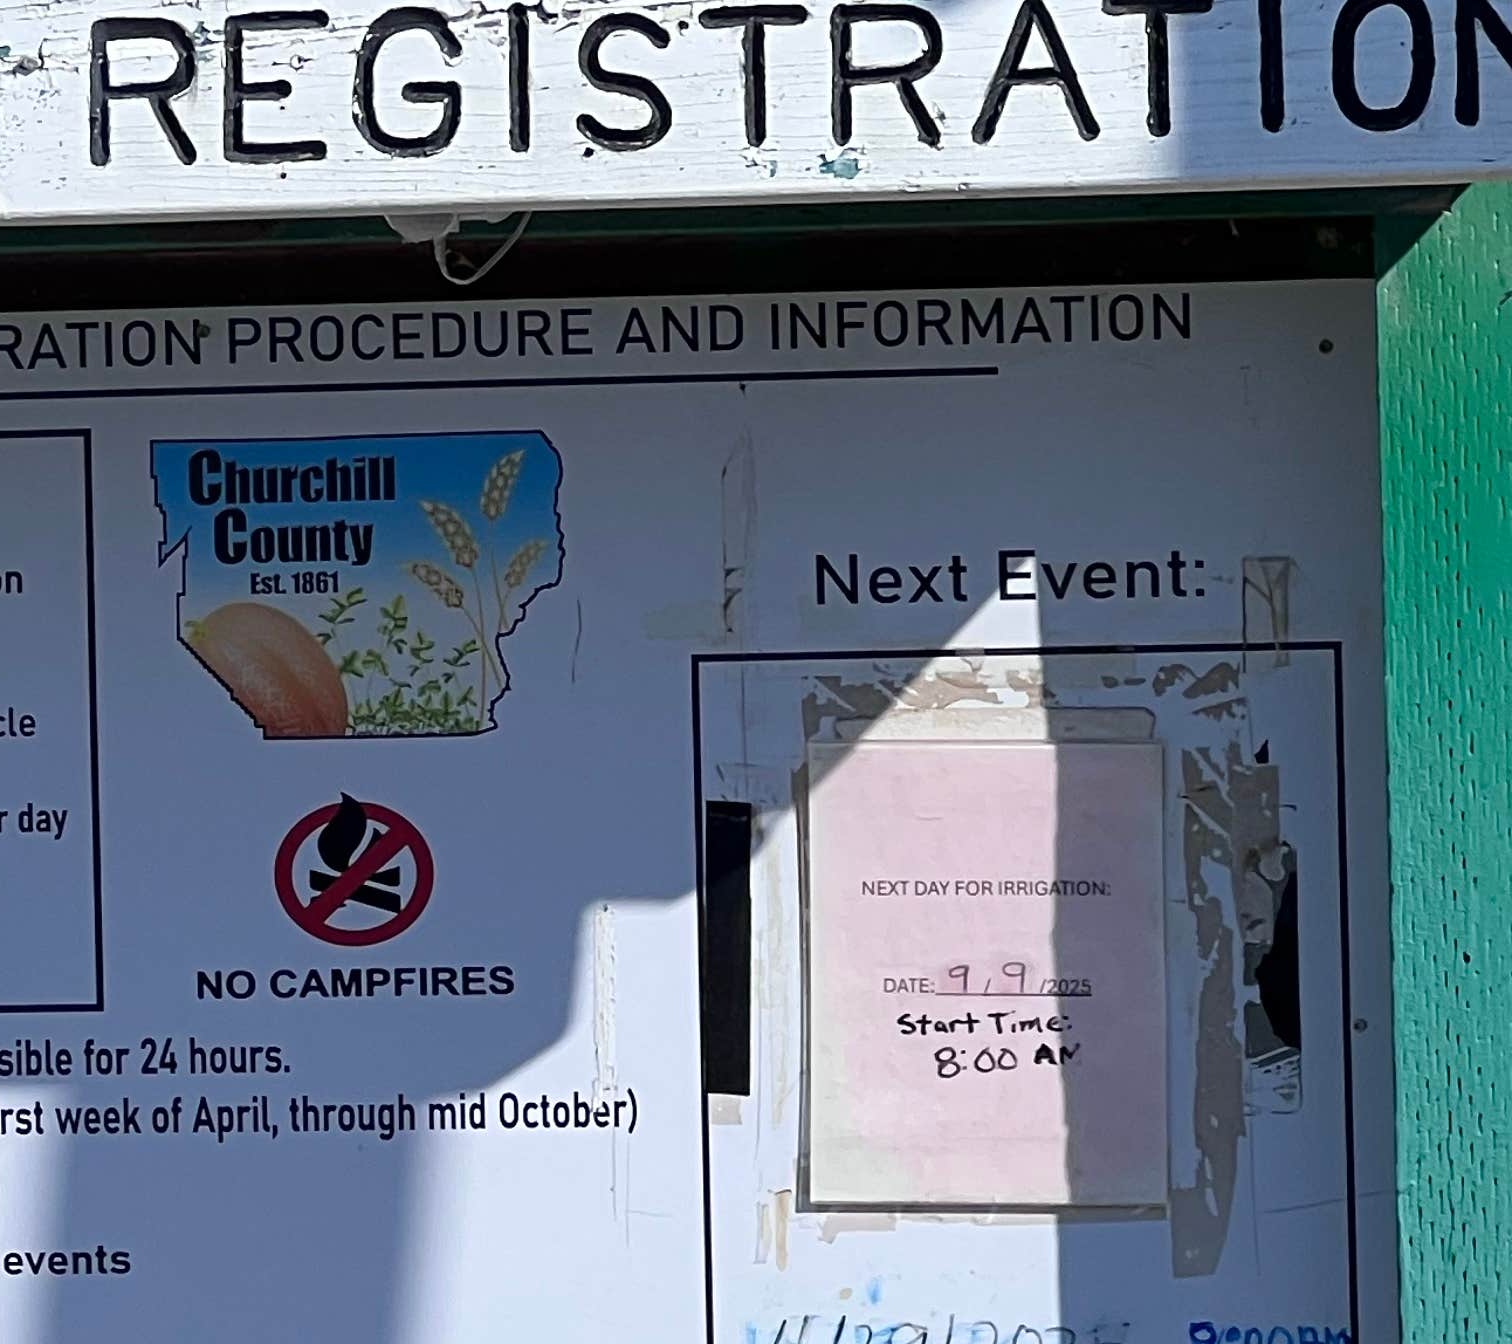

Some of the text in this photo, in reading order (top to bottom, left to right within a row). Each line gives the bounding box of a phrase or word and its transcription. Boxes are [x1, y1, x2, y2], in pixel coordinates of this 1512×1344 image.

[227, 308, 593, 364] PROCEDURE
[616, 305, 743, 354] AND
[771, 292, 1190, 350] INFORMATION
[188, 449, 396, 506] Churchill
[214, 508, 374, 566] County
[251, 571, 339, 594] Est. 1861
[816, 550, 1205, 605] Next Event:
[18, 803, 68, 840] day
[861, 880, 1111, 896] NEXT DAY FOR IRRIGATION:
[197, 966, 514, 1000] NO CAMPFIRES
[883, 978, 936, 994] DATE:
[896, 1012, 980, 1036] Start
[83, 1039, 130, 1075] for
[140, 1038, 177, 1074] 24
[189, 1037, 290, 1074] hours.
[935, 1047, 1018, 1078] 8:00
[55, 1097, 142, 1134] week
[152, 1097, 182, 1133] of
[192, 1096, 278, 1143] April,
[289, 1094, 415, 1140] through
[429, 1093, 486, 1130] mid
[499, 1088, 637, 1134] October)
